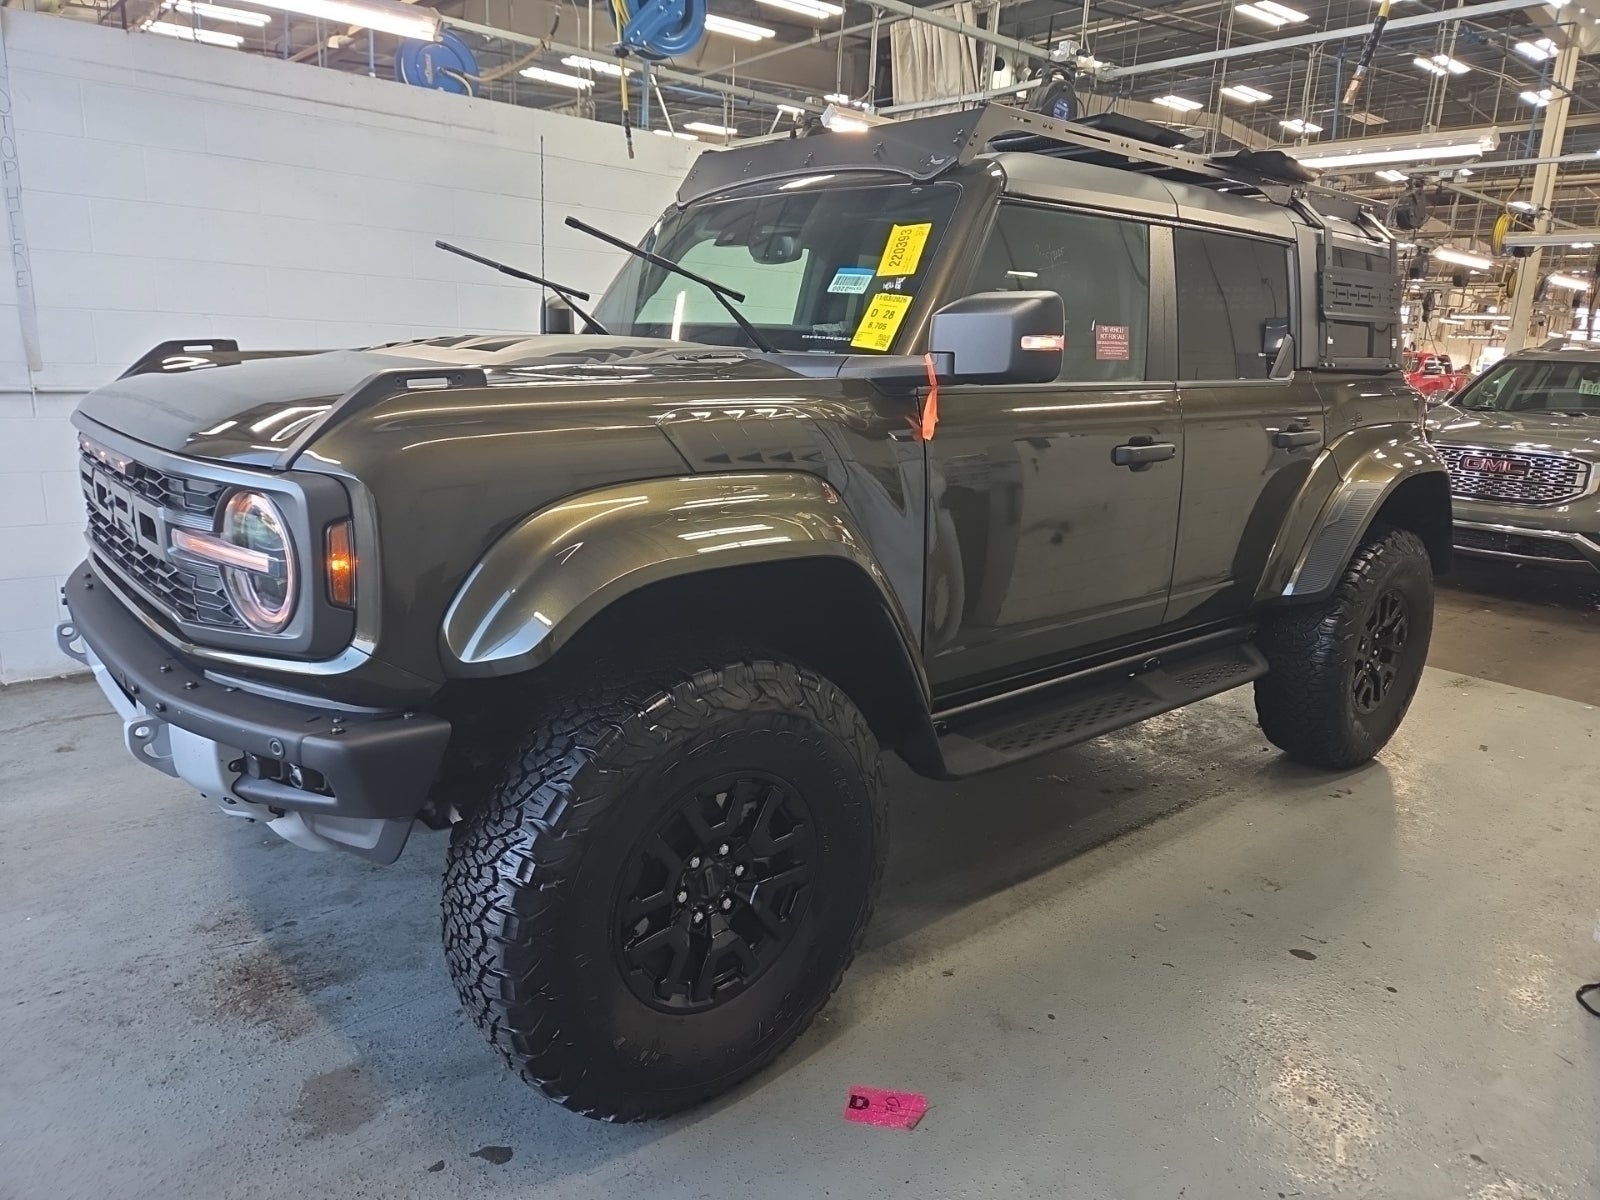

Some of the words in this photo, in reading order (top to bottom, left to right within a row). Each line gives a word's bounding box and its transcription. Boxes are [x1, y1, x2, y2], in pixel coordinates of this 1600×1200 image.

[6, 186, 30, 288] HERE
[888, 228, 913, 267] 220393
[870, 308, 879, 318] D
[882, 310, 896, 319] 28
[1581, 382, 1600, 395] 140
[1463, 456, 1527, 475] GMC
[848, 1094, 870, 1110] D
